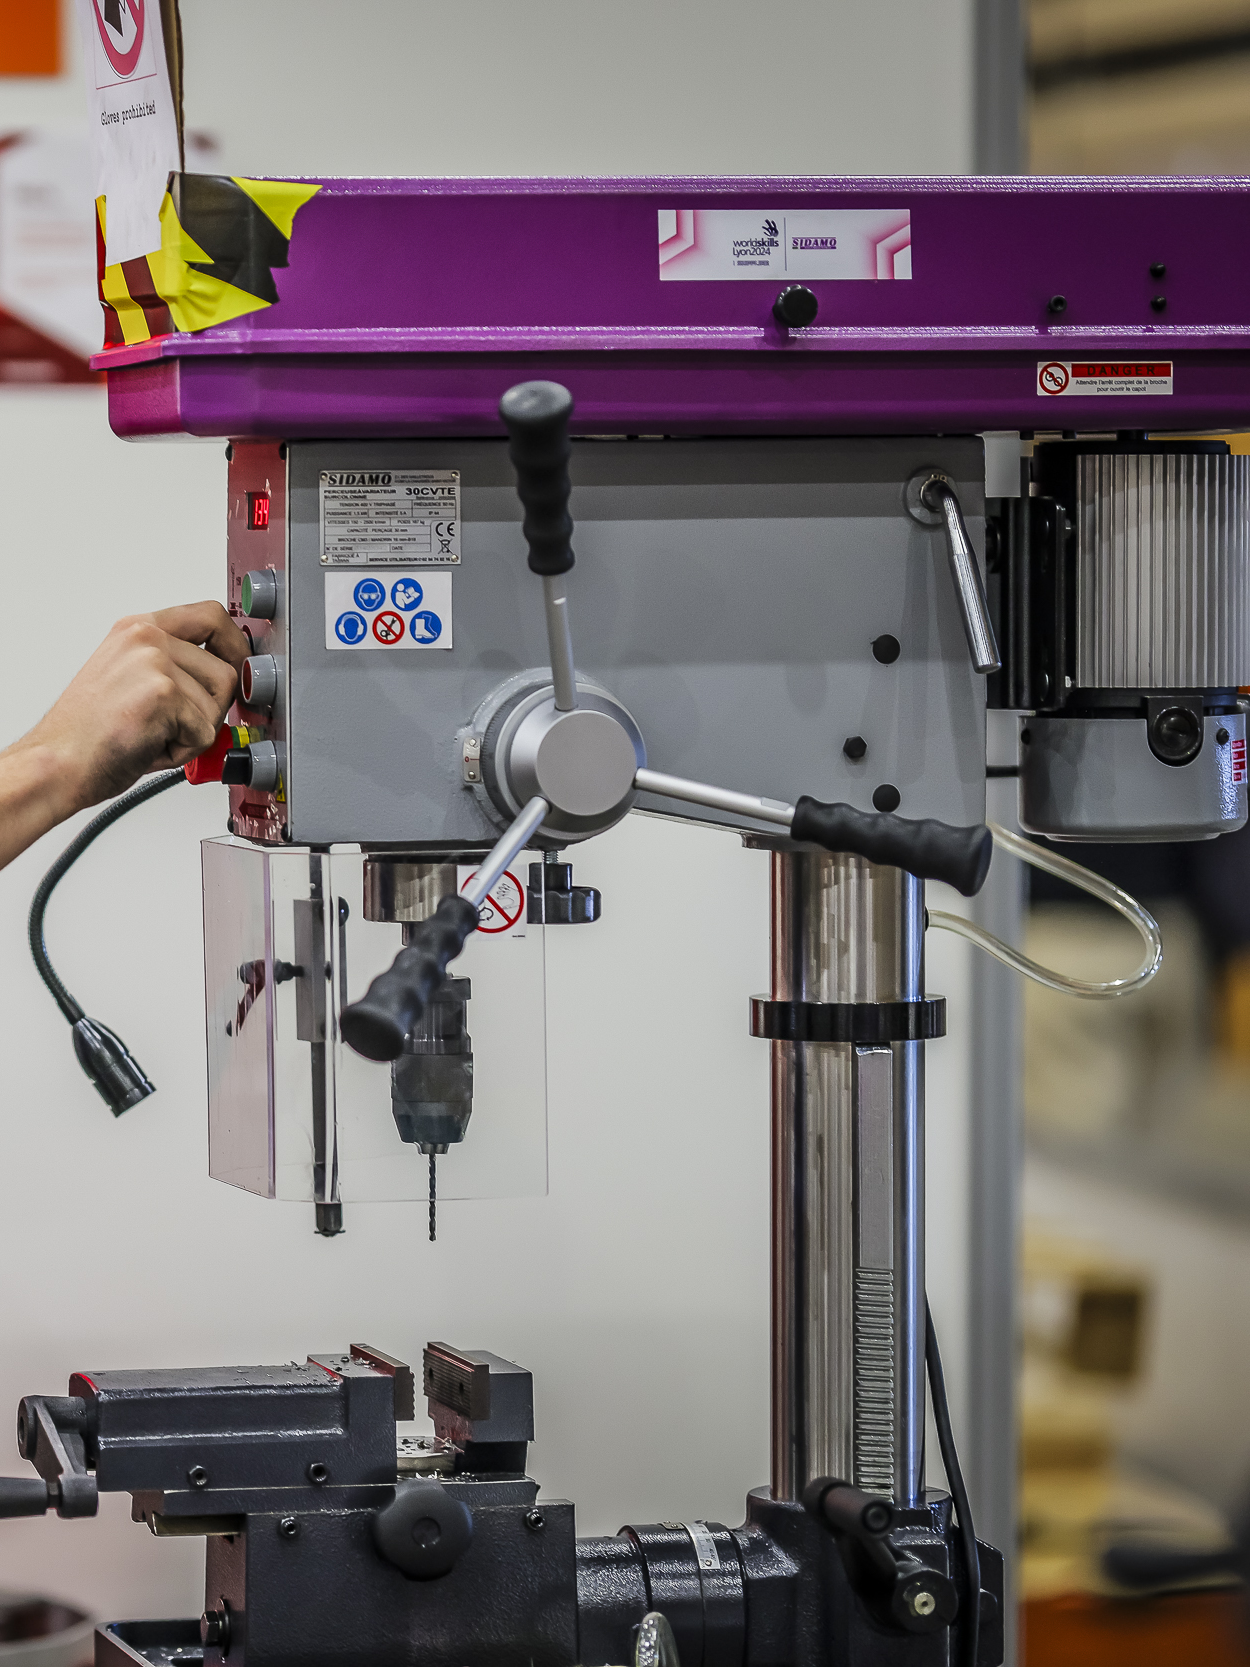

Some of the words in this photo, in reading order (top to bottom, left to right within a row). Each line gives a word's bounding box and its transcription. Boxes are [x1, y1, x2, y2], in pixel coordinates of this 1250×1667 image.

[100, 110, 120, 126] Gloves
[121, 99, 156, 126] prohibited
[733, 238, 779, 248] worldskills
[792, 237, 837, 249] SIDAMO
[732, 247, 771, 258] Lyon2024
[1087, 365, 1156, 376] DANGER
[328, 473, 392, 487] SIDAMO
[405, 487, 456, 496] 30CVTE
[253, 498, 270, 526] 134
